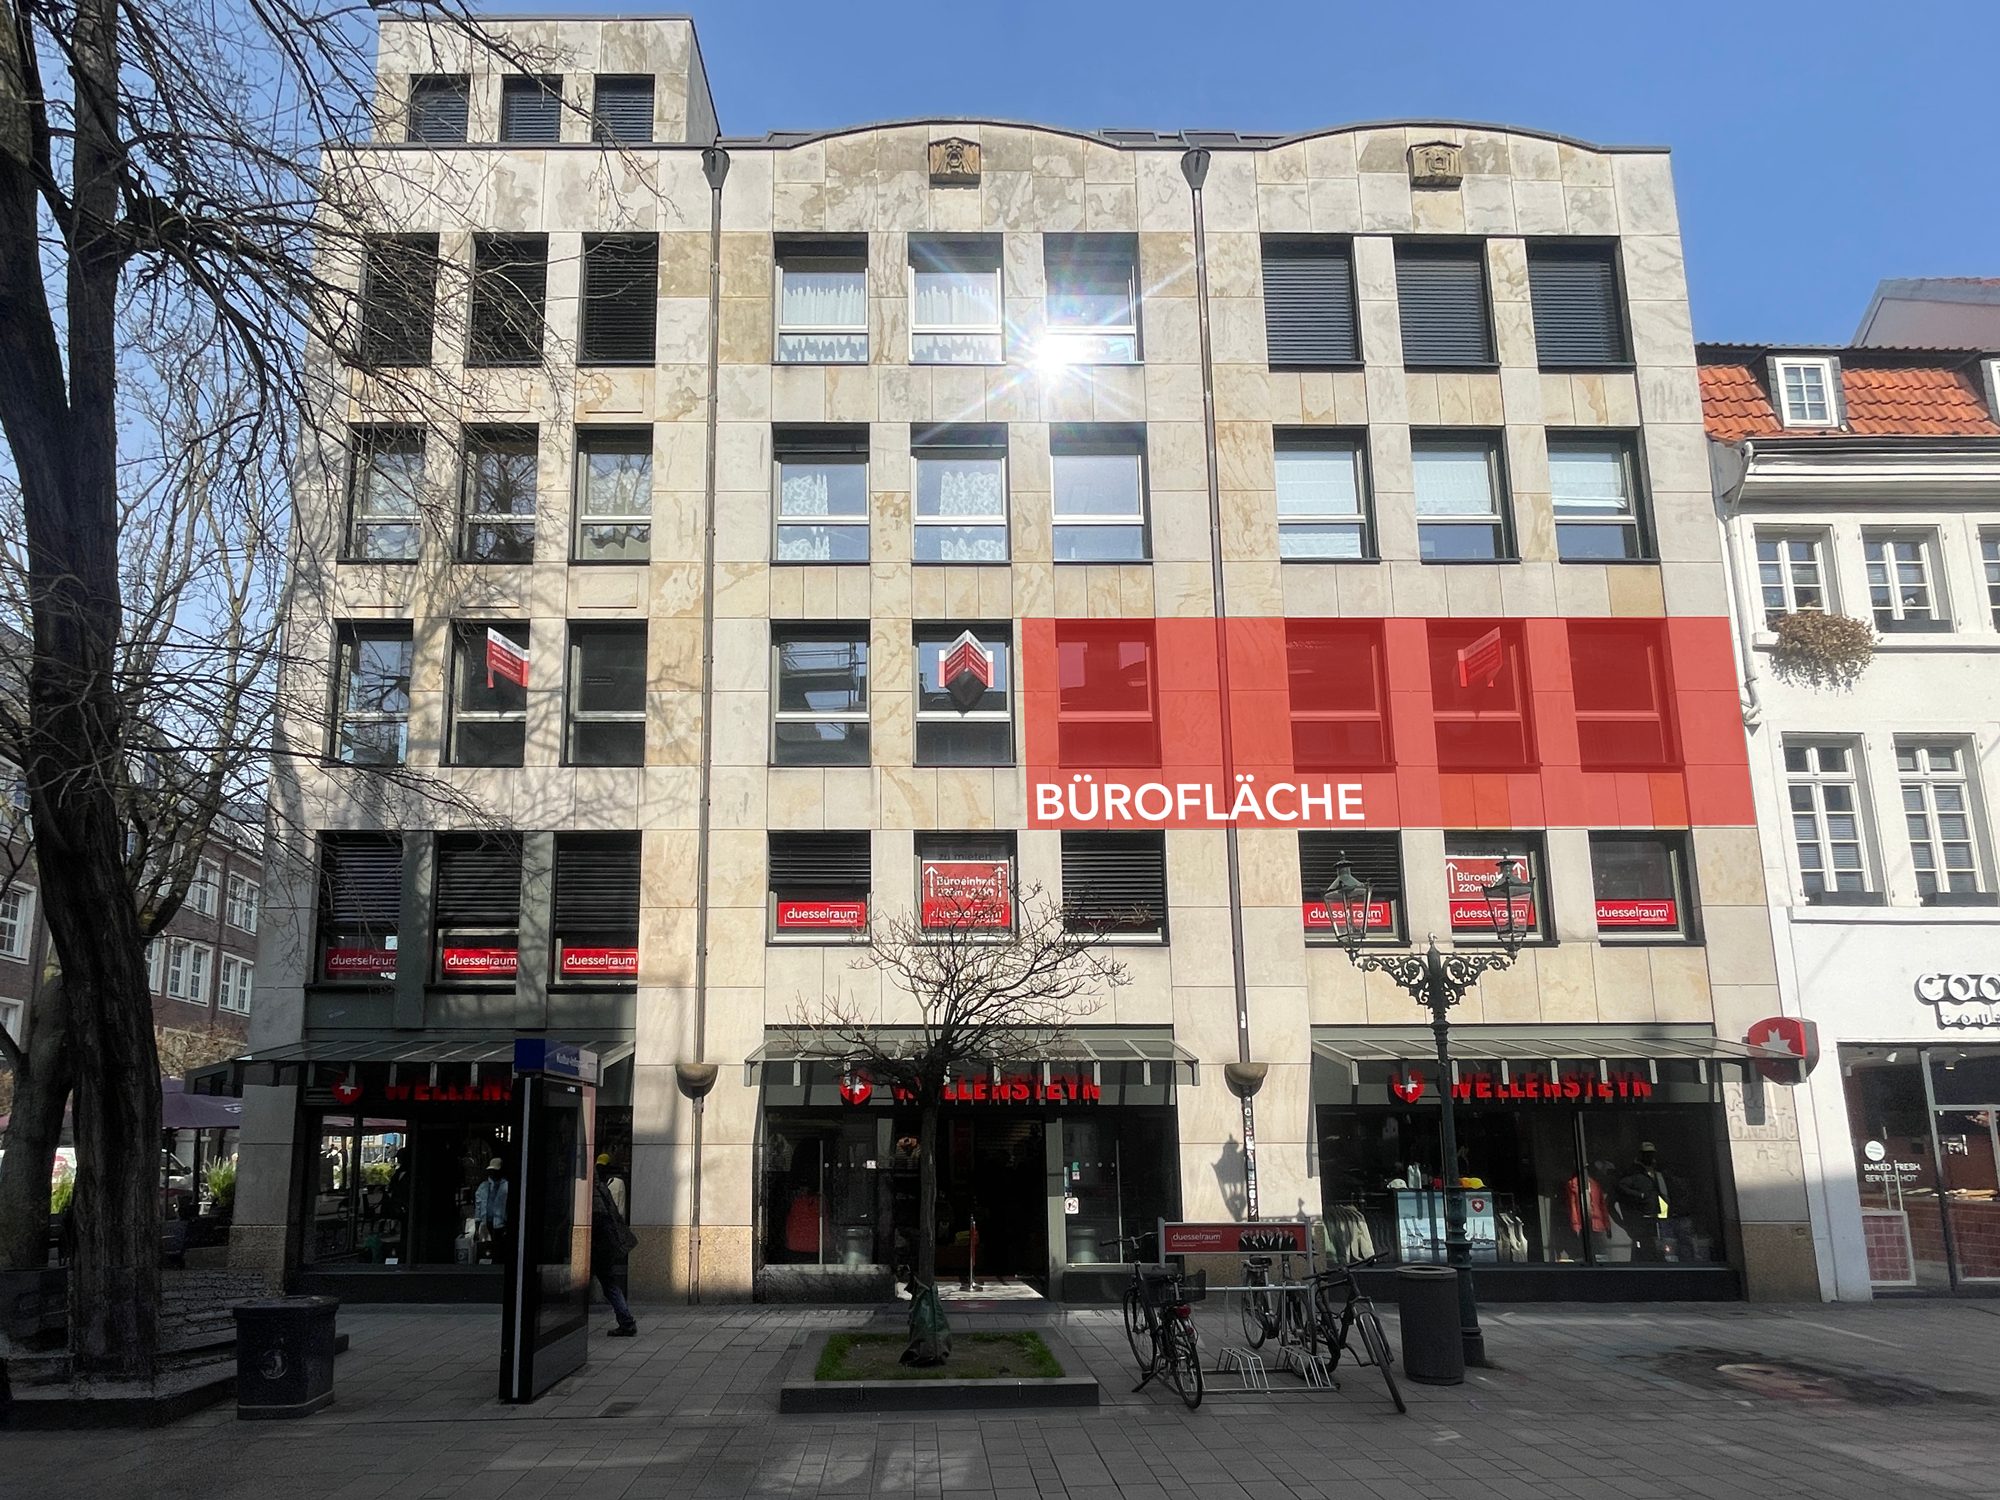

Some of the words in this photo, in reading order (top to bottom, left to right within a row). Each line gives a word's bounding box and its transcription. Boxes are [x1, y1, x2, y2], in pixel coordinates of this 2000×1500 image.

[787, 907, 858, 919] duesselraum
[1597, 906, 1667, 918] duesselraum
[448, 954, 517, 966] duesselraum
[566, 954, 636, 966] duesselraum
[1863, 1163, 1892, 1171] BAKED
[1865, 1174, 1896, 1182] SERVED
[1900, 1174, 1918, 1182] HOT
[1172, 1232, 1221, 1241] duesselraum
